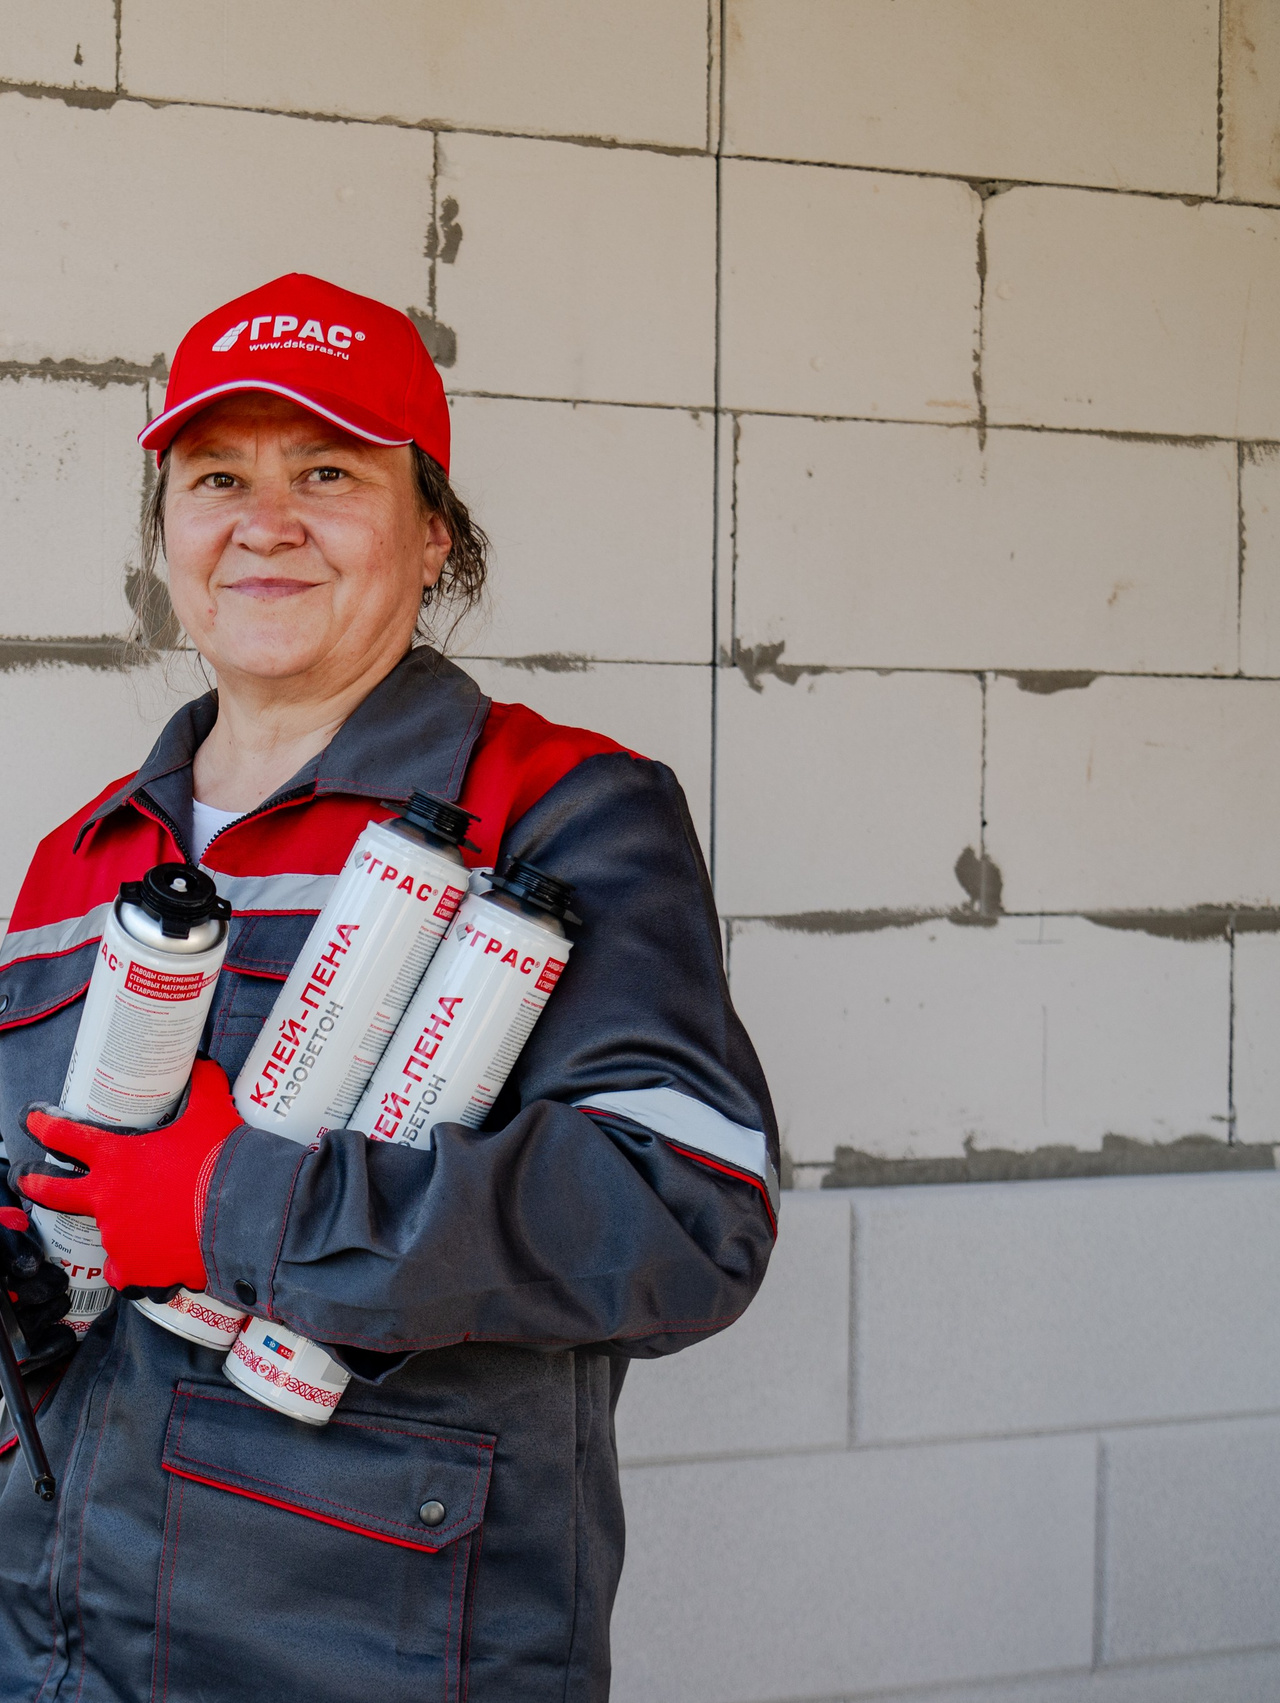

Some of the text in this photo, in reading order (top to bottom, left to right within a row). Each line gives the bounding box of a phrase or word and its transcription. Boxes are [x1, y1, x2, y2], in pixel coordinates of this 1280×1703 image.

[249, 339, 350, 361] www.dskgras.ru
[129, 973, 161, 990] СТЕНОВЫХ
[161, 982, 198, 992] МАТЕРИАЛОВ
[131, 964, 157, 980] ЗАВОДЫ
[157, 974, 200, 984] СОВРЕМЕННЫХ
[132, 984, 185, 1000] СТАВРОПОЛЬСКОМ
[249, 924, 360, 1109] КЛЕЙ-ПЕНА
[273, 1000, 344, 1118] ГАЗОБЕТОН
[370, 997, 464, 1142] ЕЙ-ПЕНА
[398, 1074, 447, 1148] БЕТОН
[51, 1238, 72, 1254] 750ml
[71, 1265, 105, 1280] ГР
